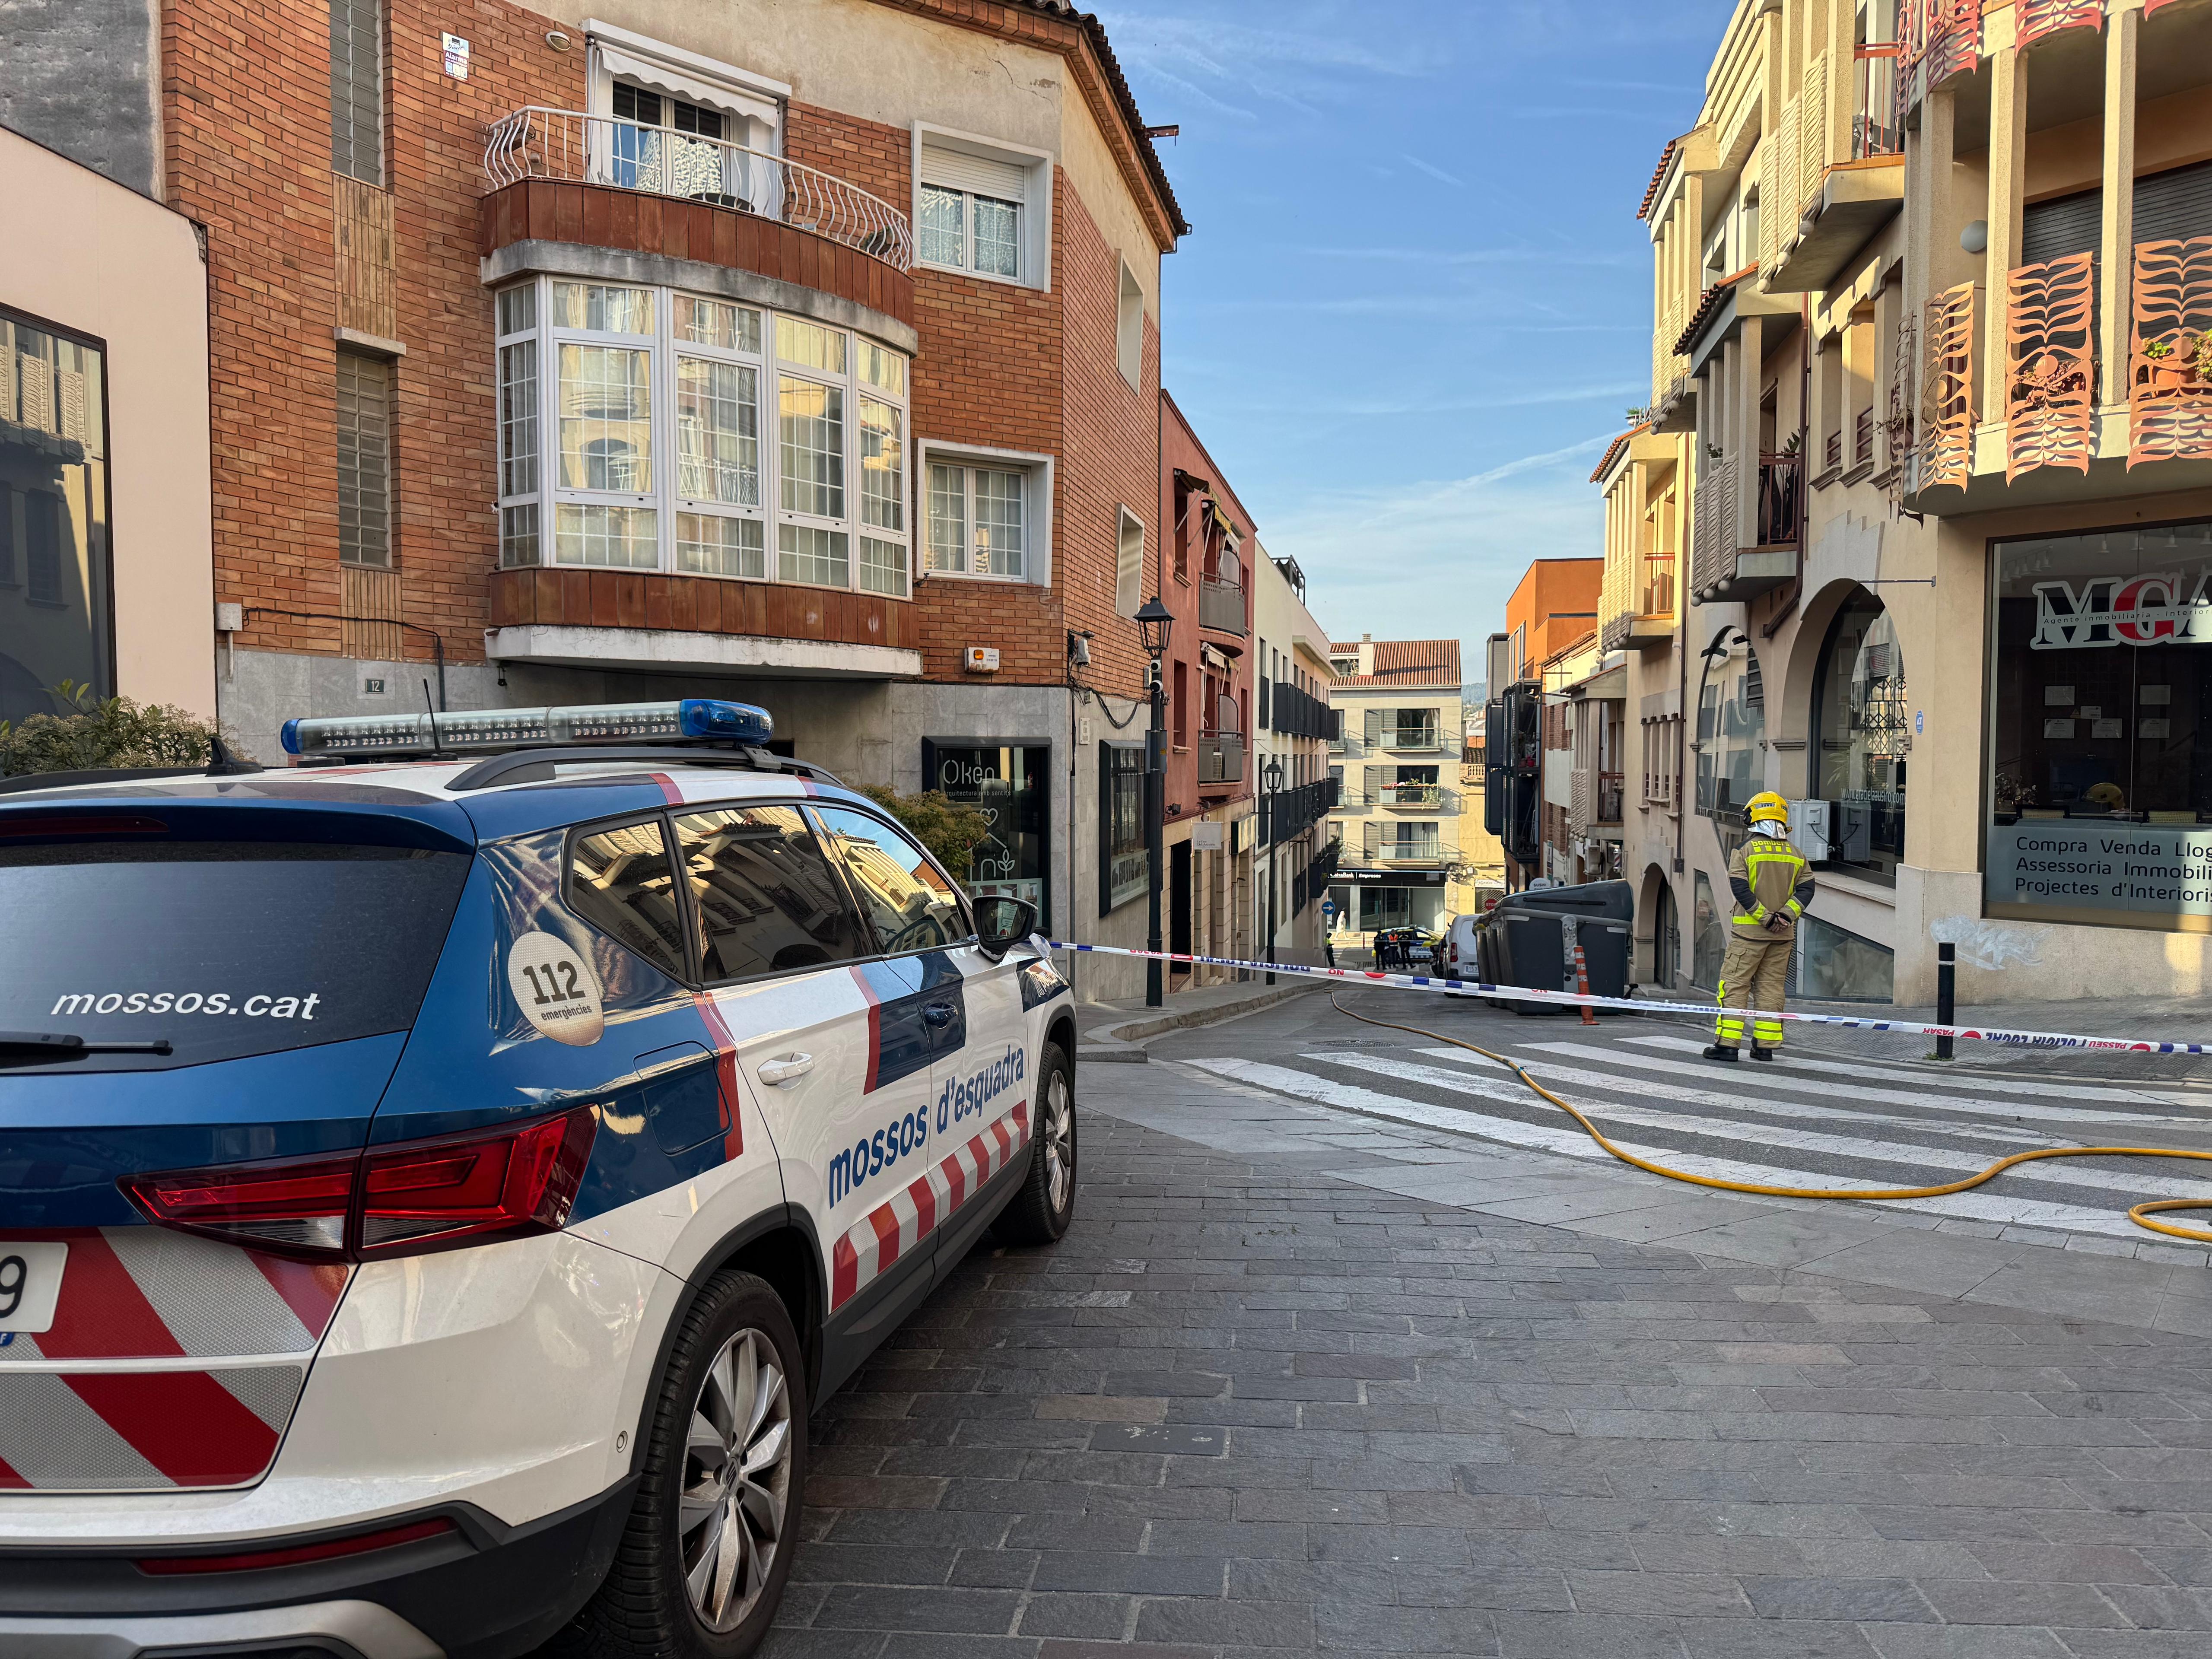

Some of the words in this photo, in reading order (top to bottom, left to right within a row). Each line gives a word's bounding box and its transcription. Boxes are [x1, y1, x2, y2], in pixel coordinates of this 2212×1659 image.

[445, 51, 468, 65] Alarma
[2044, 617, 2079, 625] Agente
[2085, 612, 2151, 621] inmobiliaria
[371, 680, 380, 691] 12
[943, 760, 995, 784] Oken
[2017, 836, 2088, 855] Compra
[2100, 839, 2161, 855] Venda
[2016, 857, 2111, 875] Assessoria
[2124, 862, 2212, 880] Immobili
[2015, 877, 2098, 896] Projectes
[2111, 882, 2212, 902] d'Interiori
[522, 960, 586, 1005] 112
[50, 992, 321, 1020] mossos.cat
[541, 1004, 592, 1021] emergències
[830, 1105, 928, 1210] mossos
[937, 1044, 1023, 1134] d'esquadra
